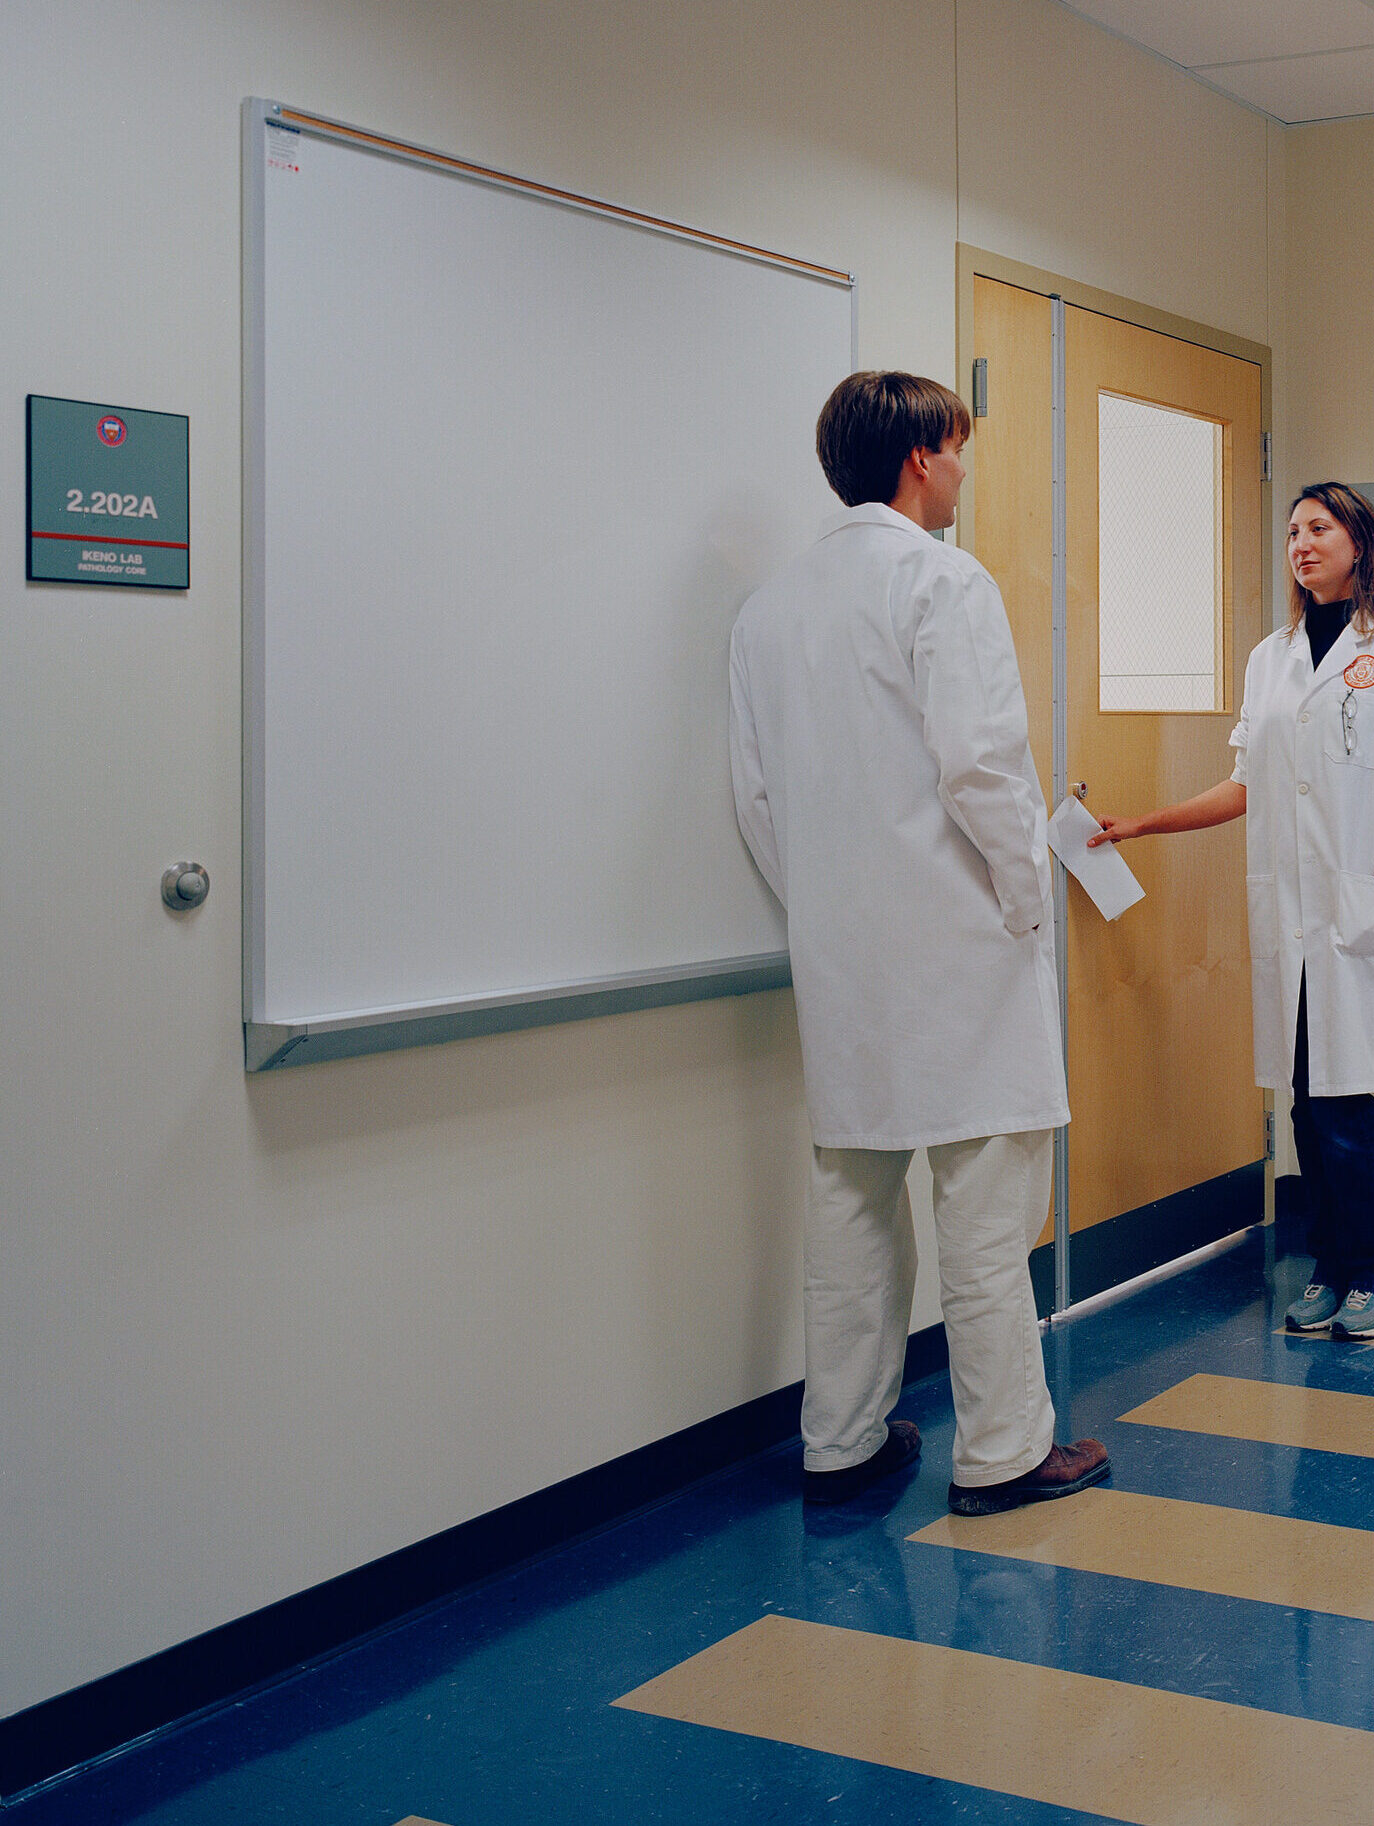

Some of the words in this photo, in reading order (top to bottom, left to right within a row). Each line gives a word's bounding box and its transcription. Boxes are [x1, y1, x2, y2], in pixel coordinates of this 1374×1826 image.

[66, 488, 158, 519] 2.202A
[82, 550, 117, 563] IKENO
[120, 553, 143, 565] LAB
[77, 563, 124, 573] PATHOLOGY
[125, 566, 147, 575] CORE
